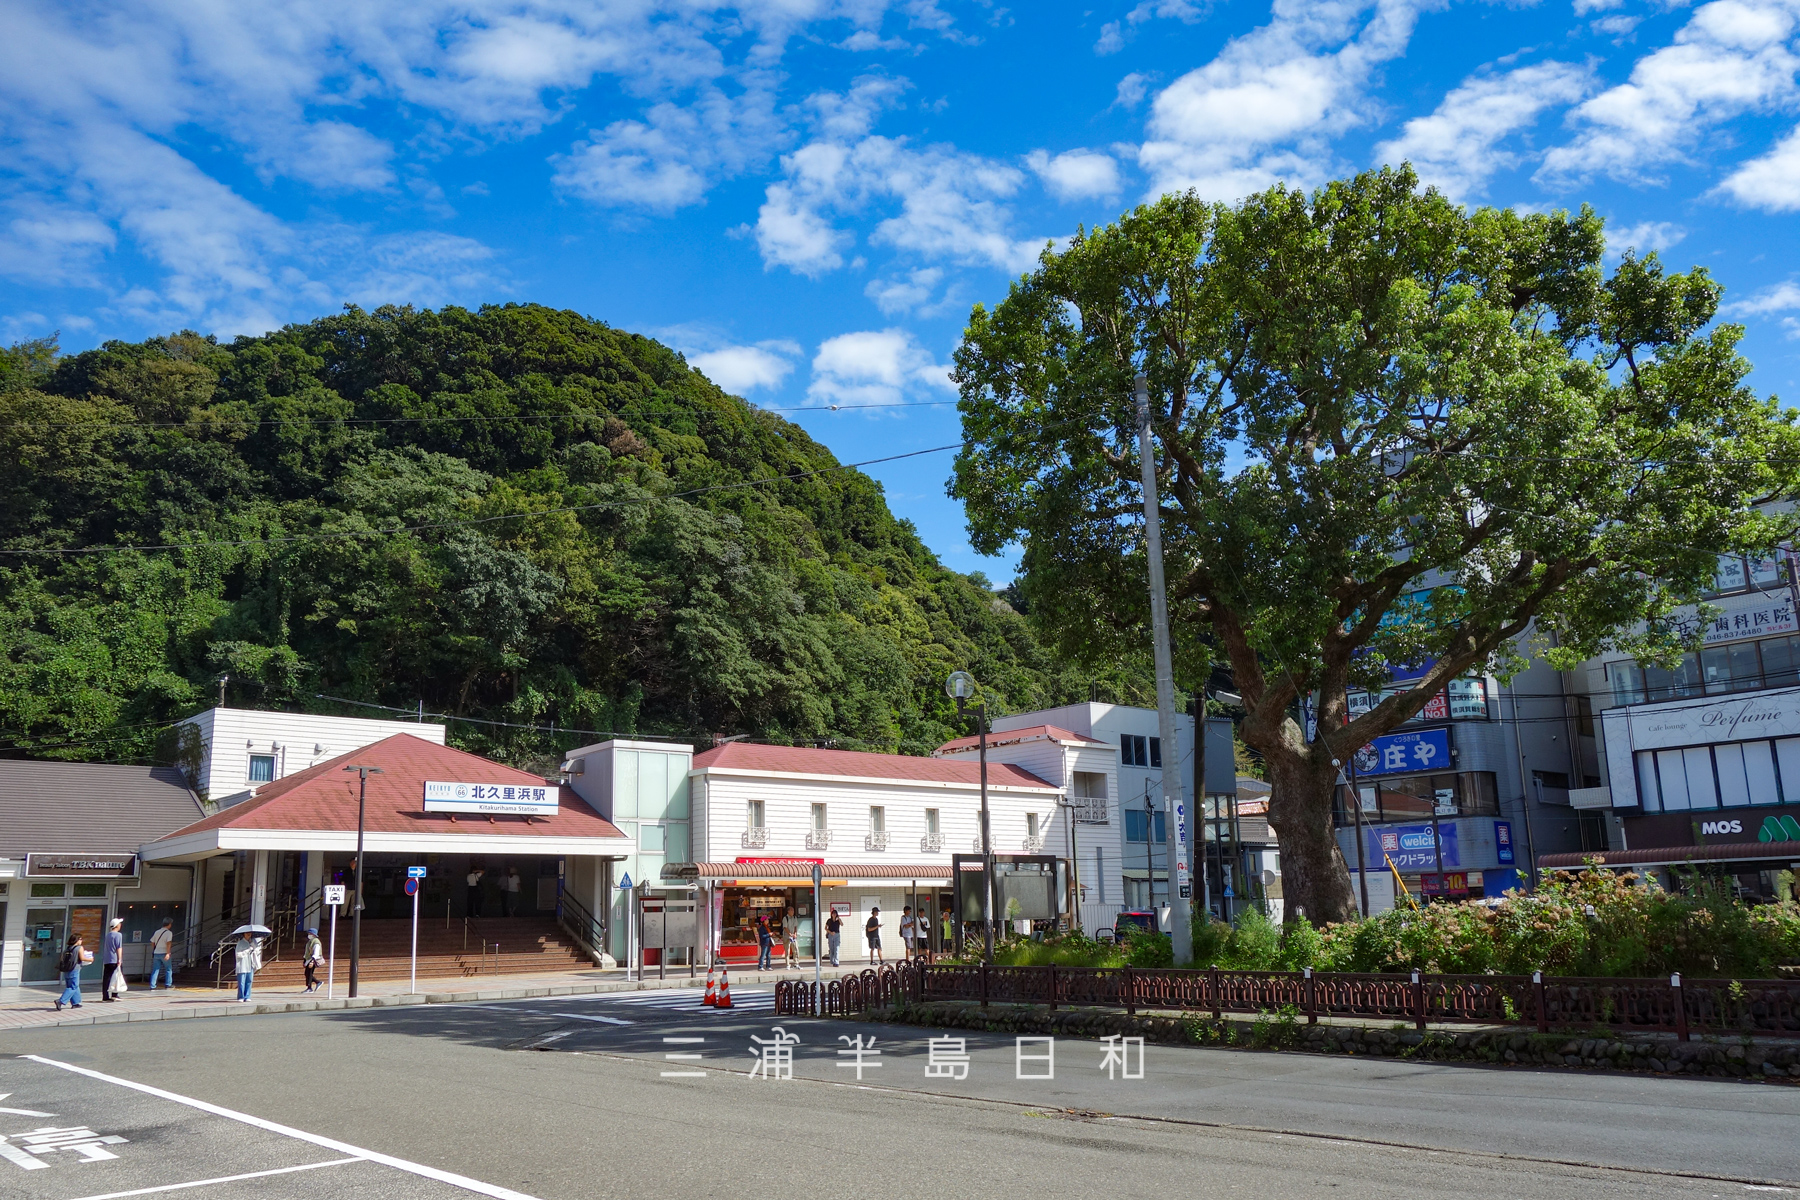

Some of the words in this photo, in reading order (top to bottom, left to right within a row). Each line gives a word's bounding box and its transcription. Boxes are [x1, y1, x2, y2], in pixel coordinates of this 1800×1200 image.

[1706, 627, 1762, 641] 046-837-6480
[1664, 722, 1688, 731] lounge
[1699, 700, 1782, 738] Perfume
[1383, 740, 1437, 770] 庄や
[429, 784, 451, 792] KEIKYO
[471, 785, 546, 801] 北久里浜駅
[479, 804, 517, 812] Kitakurihama
[1702, 820, 1743, 835] MOS
[1383, 834, 1397, 850] 薬
